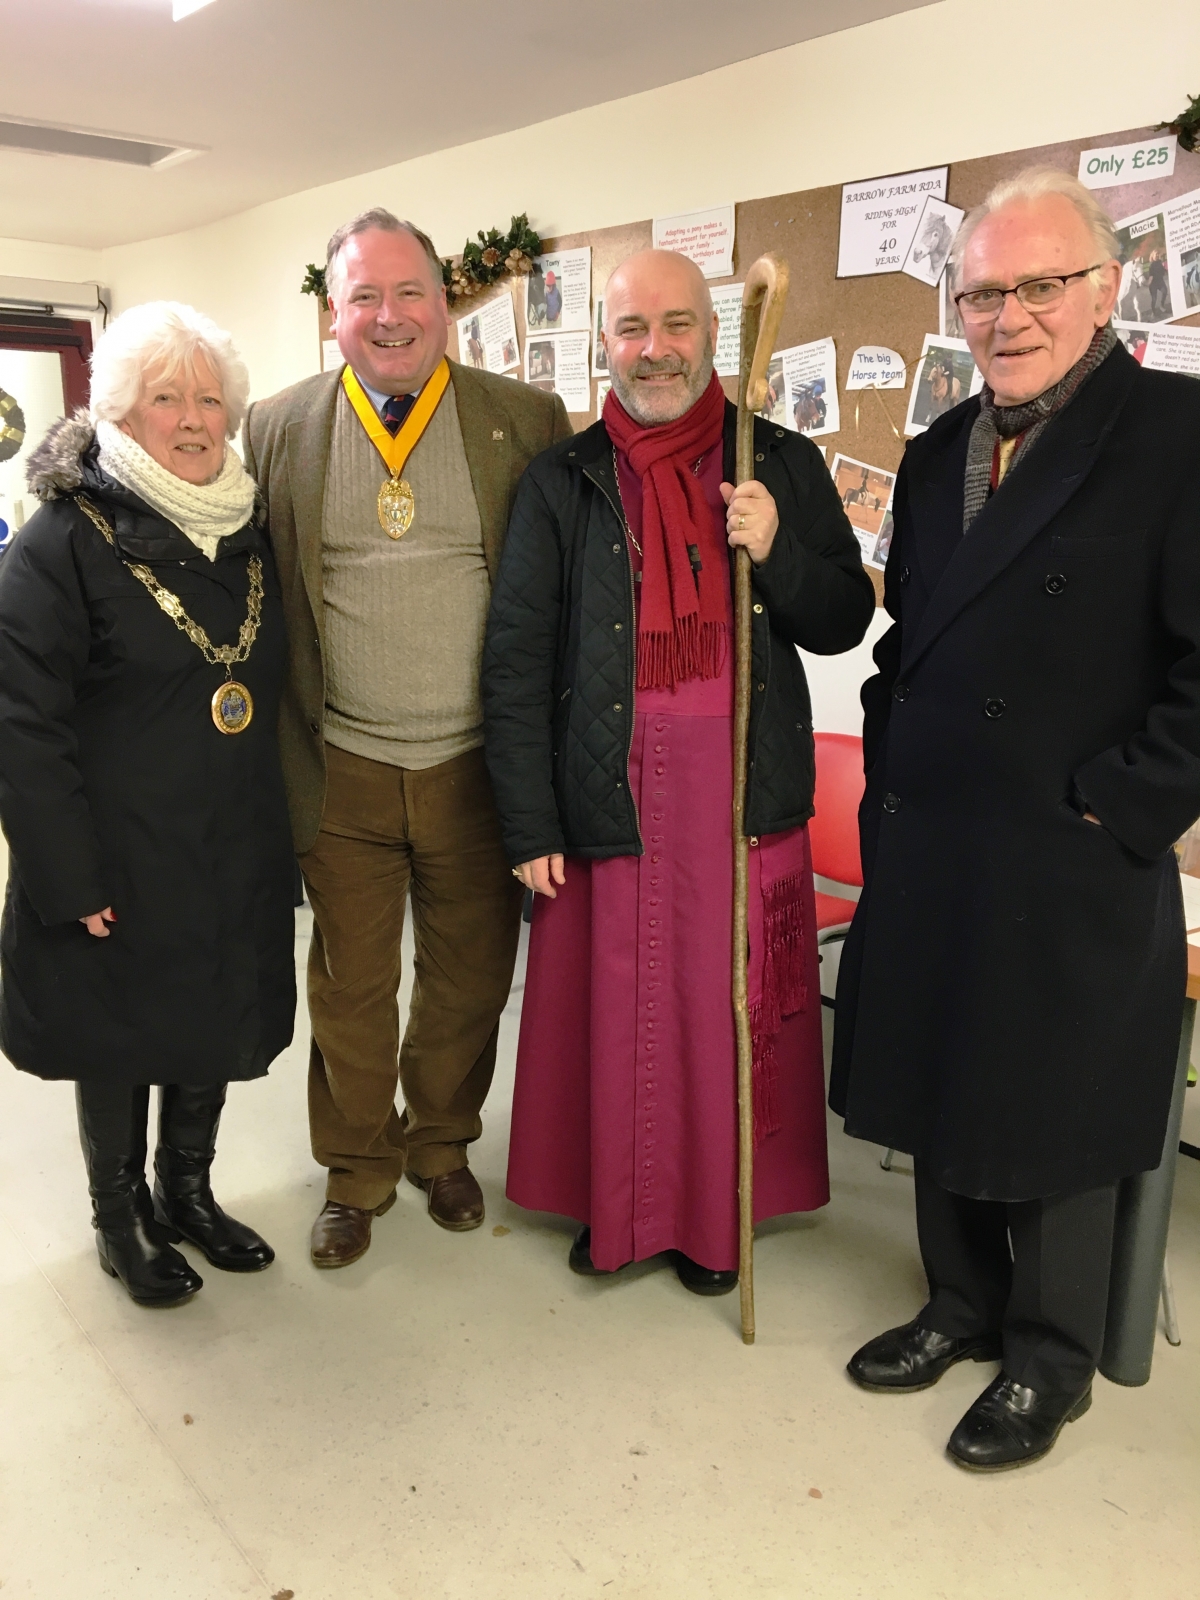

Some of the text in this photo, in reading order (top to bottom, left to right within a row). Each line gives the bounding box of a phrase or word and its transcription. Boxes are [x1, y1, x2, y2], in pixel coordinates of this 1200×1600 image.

[1087, 147, 1168, 176] Only £25
[846, 180, 941, 203] BARROW FARM RDA
[865, 204, 918, 220] RIDING HIGH
[881, 220, 897, 231] FOR
[1131, 221, 1155, 235] Macie
[665, 228, 685, 237] Adopting
[659, 238, 679, 247] fantastic
[681, 235, 698, 244] present
[879, 238, 896, 252] 40
[693, 250, 714, 258] birthdays
[875, 255, 900, 267] YEARS
[857, 353, 891, 365] The big
[852, 370, 903, 380] Horse team
